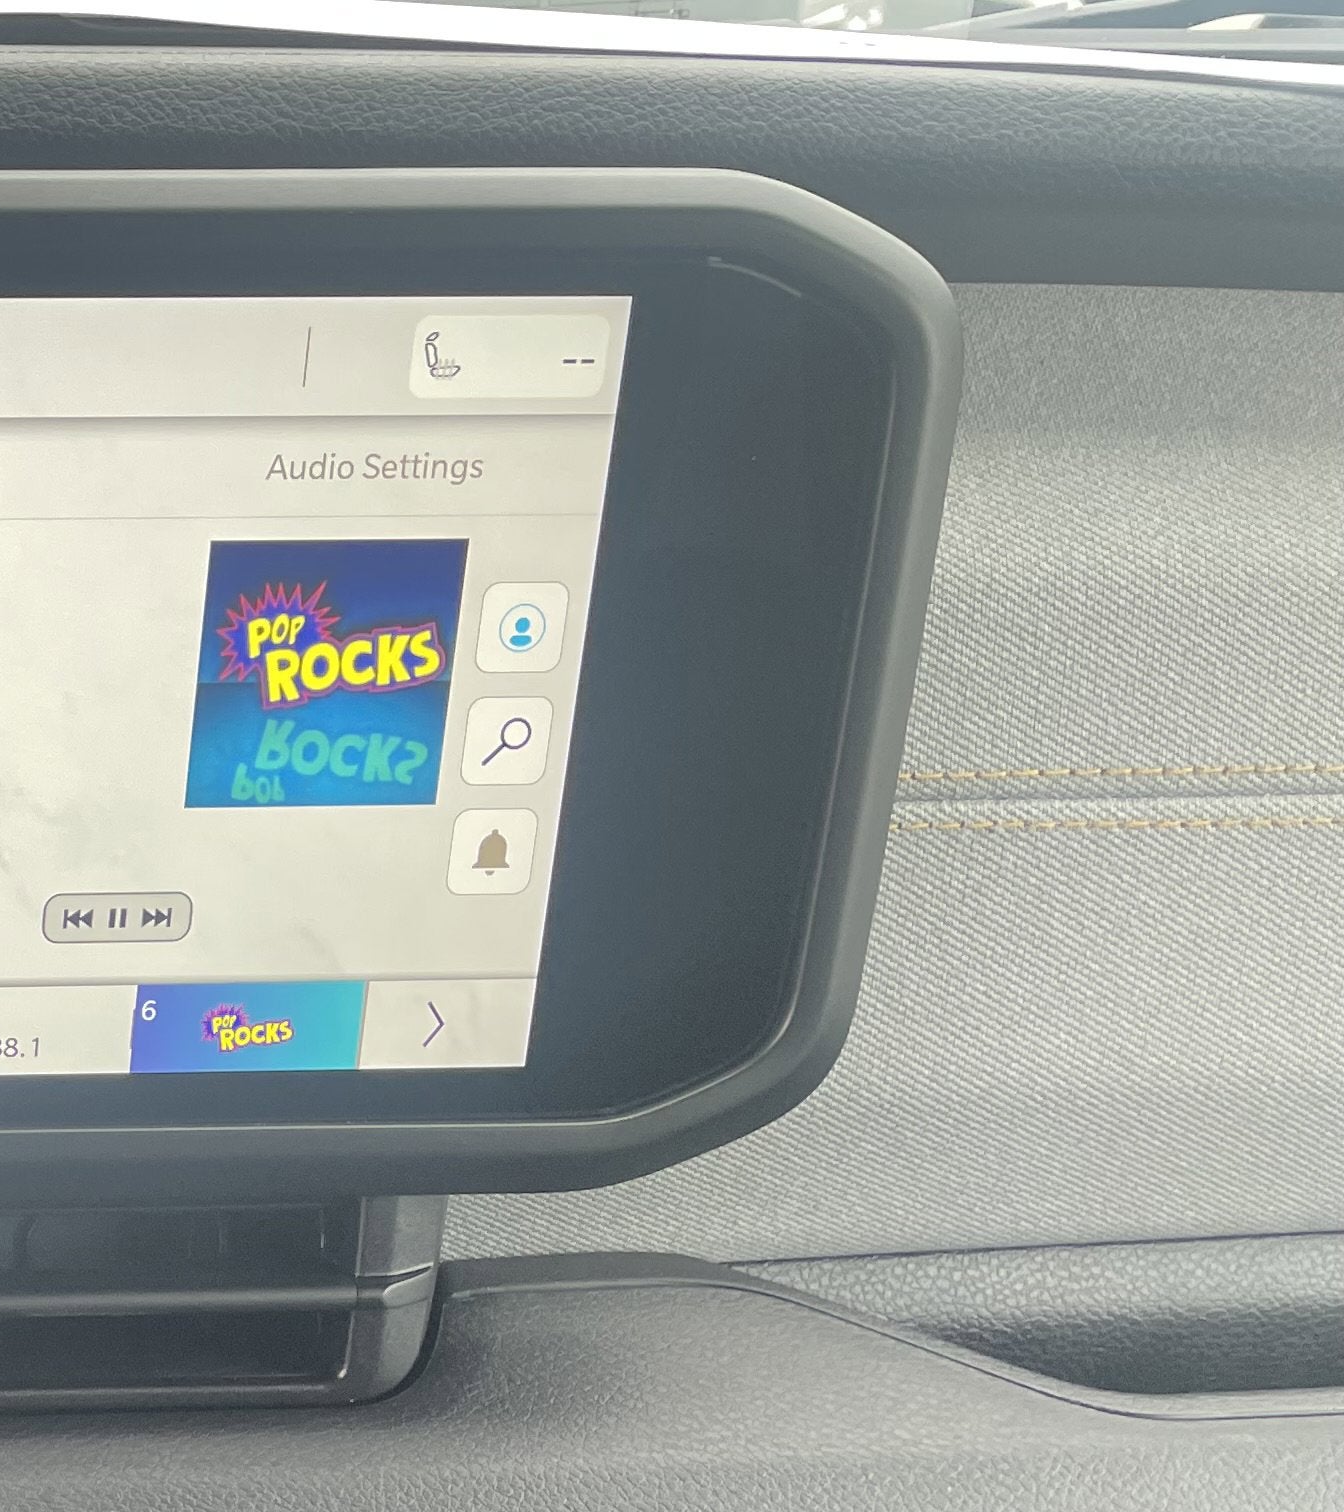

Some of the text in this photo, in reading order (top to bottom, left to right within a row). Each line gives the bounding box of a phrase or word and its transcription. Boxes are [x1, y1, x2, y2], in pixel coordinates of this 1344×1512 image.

[266, 452, 484, 485] Audio Settings
[247, 613, 305, 658] POP
[265, 630, 440, 702] ROCKS
[141, 1000, 156, 1021] 6
[218, 1021, 293, 1051] ROCKS
